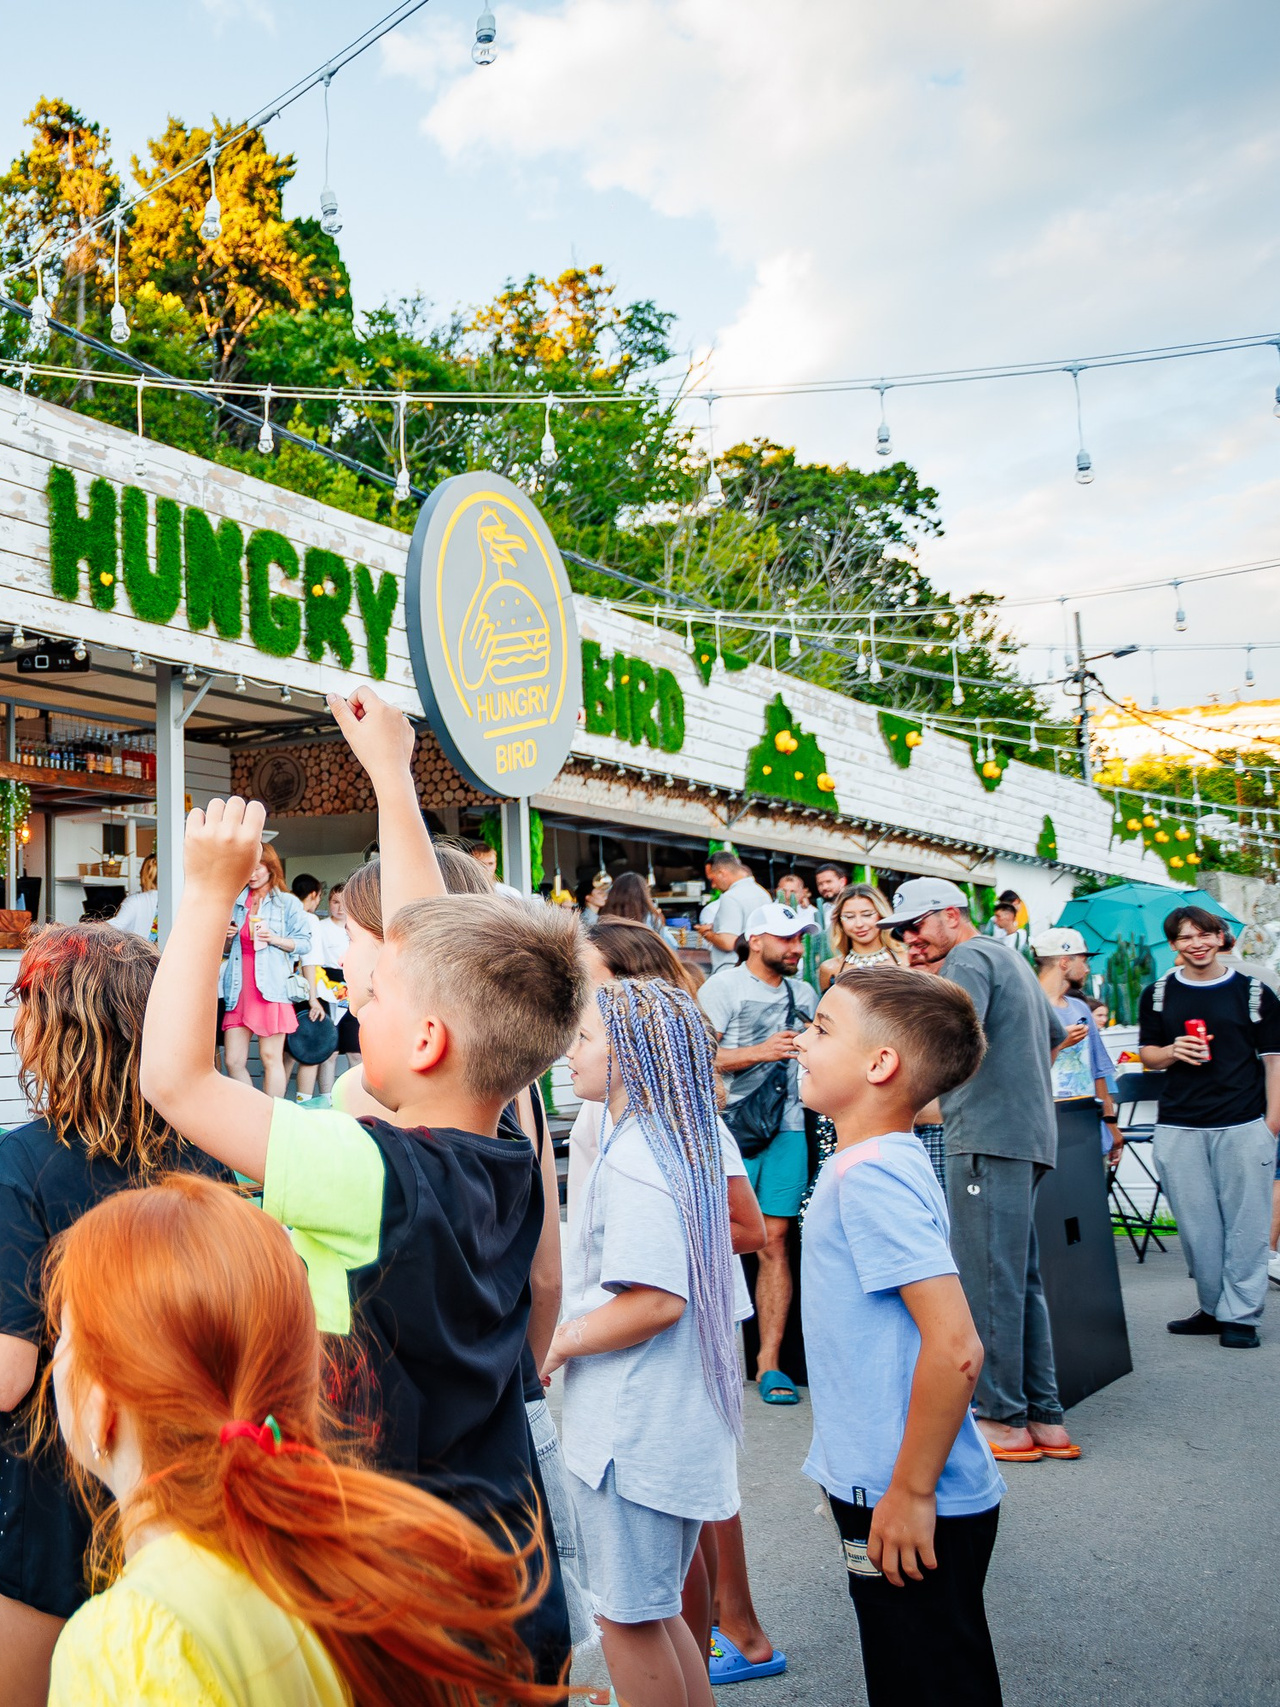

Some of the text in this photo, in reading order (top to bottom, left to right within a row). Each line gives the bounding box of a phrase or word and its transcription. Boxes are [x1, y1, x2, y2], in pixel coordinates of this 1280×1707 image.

[46, 463, 685, 754] HUNGRY BIRD
[477, 683, 550, 724] HUNGRY
[495, 738, 538, 774] BIRD
